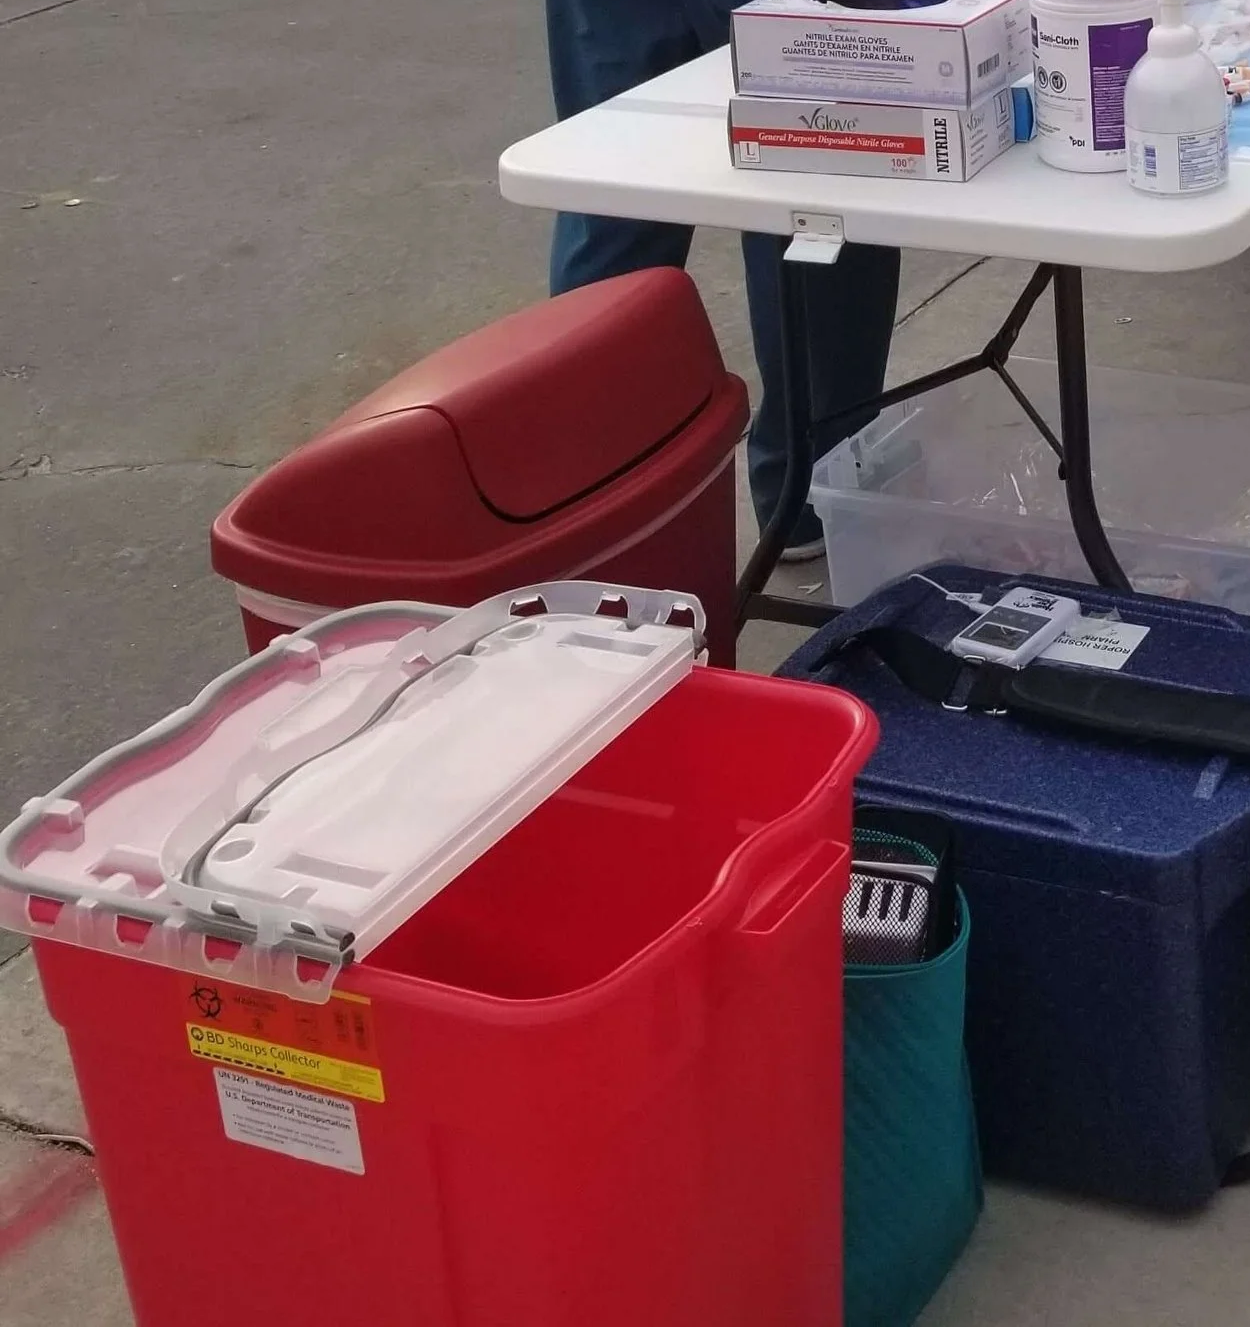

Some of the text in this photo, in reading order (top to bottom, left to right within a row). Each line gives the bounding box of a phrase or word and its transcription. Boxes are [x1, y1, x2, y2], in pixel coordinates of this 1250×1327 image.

[793, 39, 818, 49] GANTS
[860, 43, 872, 52] EN
[873, 45, 901, 54] NITRILE
[805, 33, 888, 46] NITRILE EXAM GLOVES
[781, 47, 914, 63] GUANTES DE NITRILO PARA EXAMEN
[758, 131, 905, 149] General Purpose Disposable Nitrile Gloves
[934, 117, 950, 174] NITRILE
[1072, 139, 1085, 147] PDI
[746, 142, 756, 157] L
[891, 157, 907, 169] 100
[206, 1030, 225, 1045] BD
[228, 1036, 267, 1056] Sharps
[270, 1046, 321, 1070] Collector
[255, 1079, 294, 1096] Regulated
[295, 1090, 325, 1104] Medical
[326, 1098, 350, 1111] Waste
[241, 1093, 286, 1113] Department
[286, 1105, 295, 1114] of
[296, 1107, 351, 1130] Transportation
